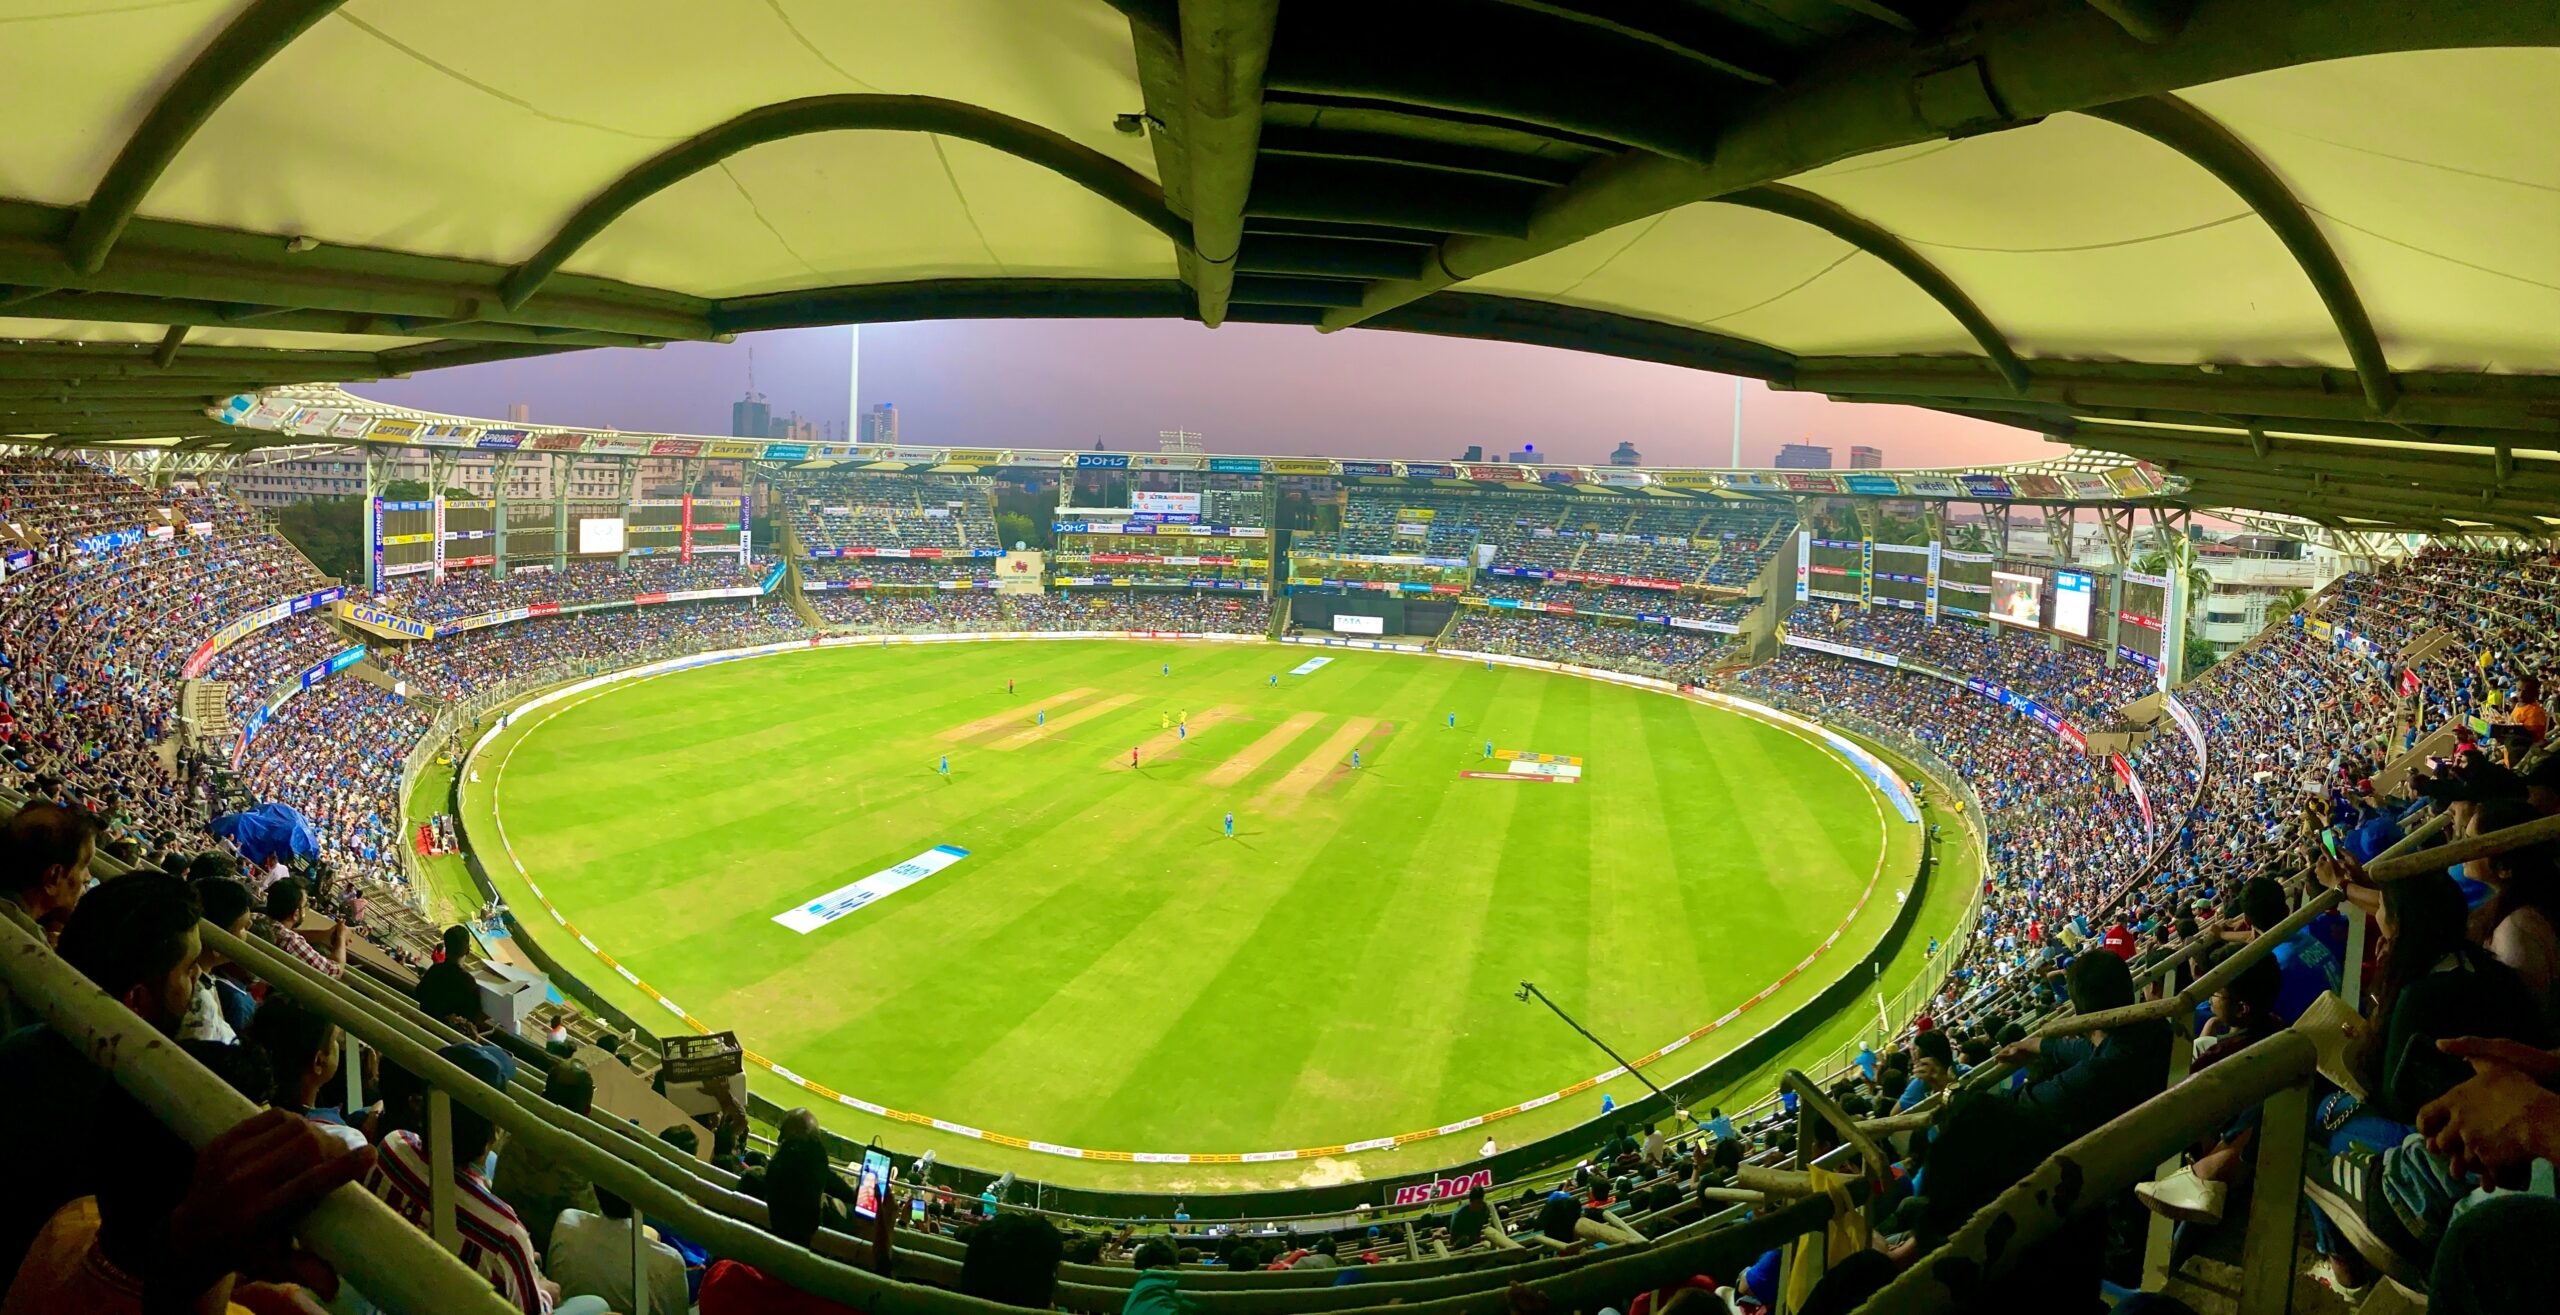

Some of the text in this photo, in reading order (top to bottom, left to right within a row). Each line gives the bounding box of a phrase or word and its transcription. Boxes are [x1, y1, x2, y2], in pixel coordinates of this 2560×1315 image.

[376, 425, 413, 437] CAPTAIN
[951, 454, 997, 462] CAPTAIN
[1080, 456, 1127, 466] DOMS
[1914, 480, 1949, 491] wakefit
[1056, 524, 1087, 532] DOMS
[1625, 577, 1650, 587] Anchor
[352, 606, 426, 637] CAPTAIN
[463, 615, 492, 628] CAPTAIN
